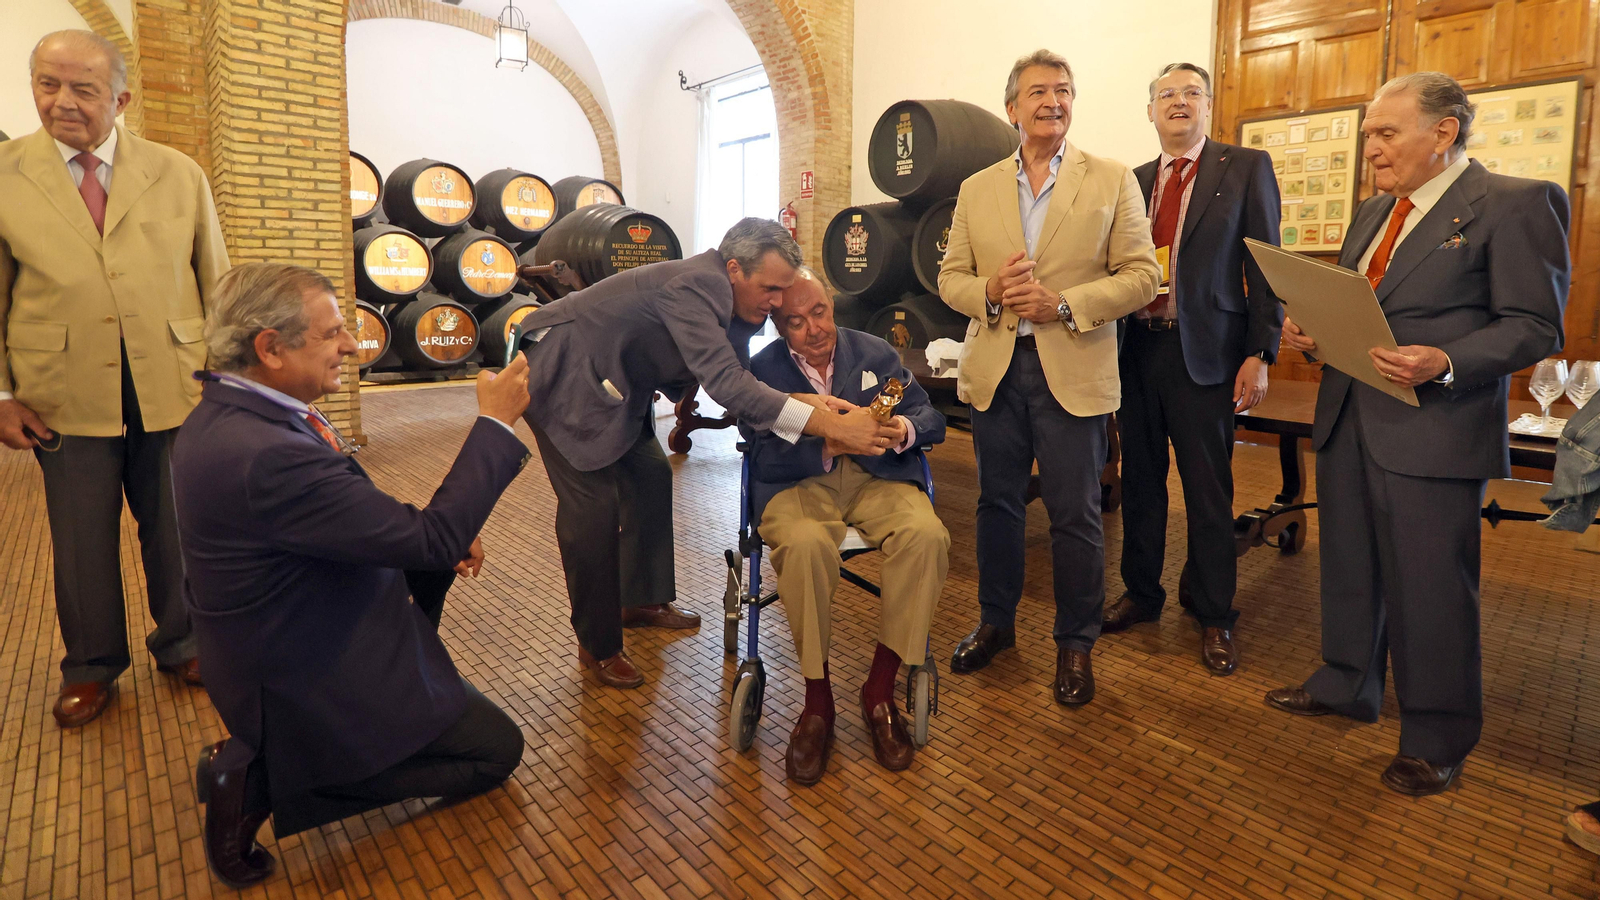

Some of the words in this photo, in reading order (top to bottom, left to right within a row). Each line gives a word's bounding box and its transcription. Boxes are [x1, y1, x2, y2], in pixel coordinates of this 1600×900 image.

[416, 197, 437, 206] MANUEL
[438, 198, 464, 208] GUERRERO
[506, 206, 518, 215] DIEZ
[520, 207, 550, 218] HERMANOS
[368, 266, 398, 276] WILLIAMS
[401, 267, 426, 276] HUMBERT
[362, 340, 379, 349] RIVA
